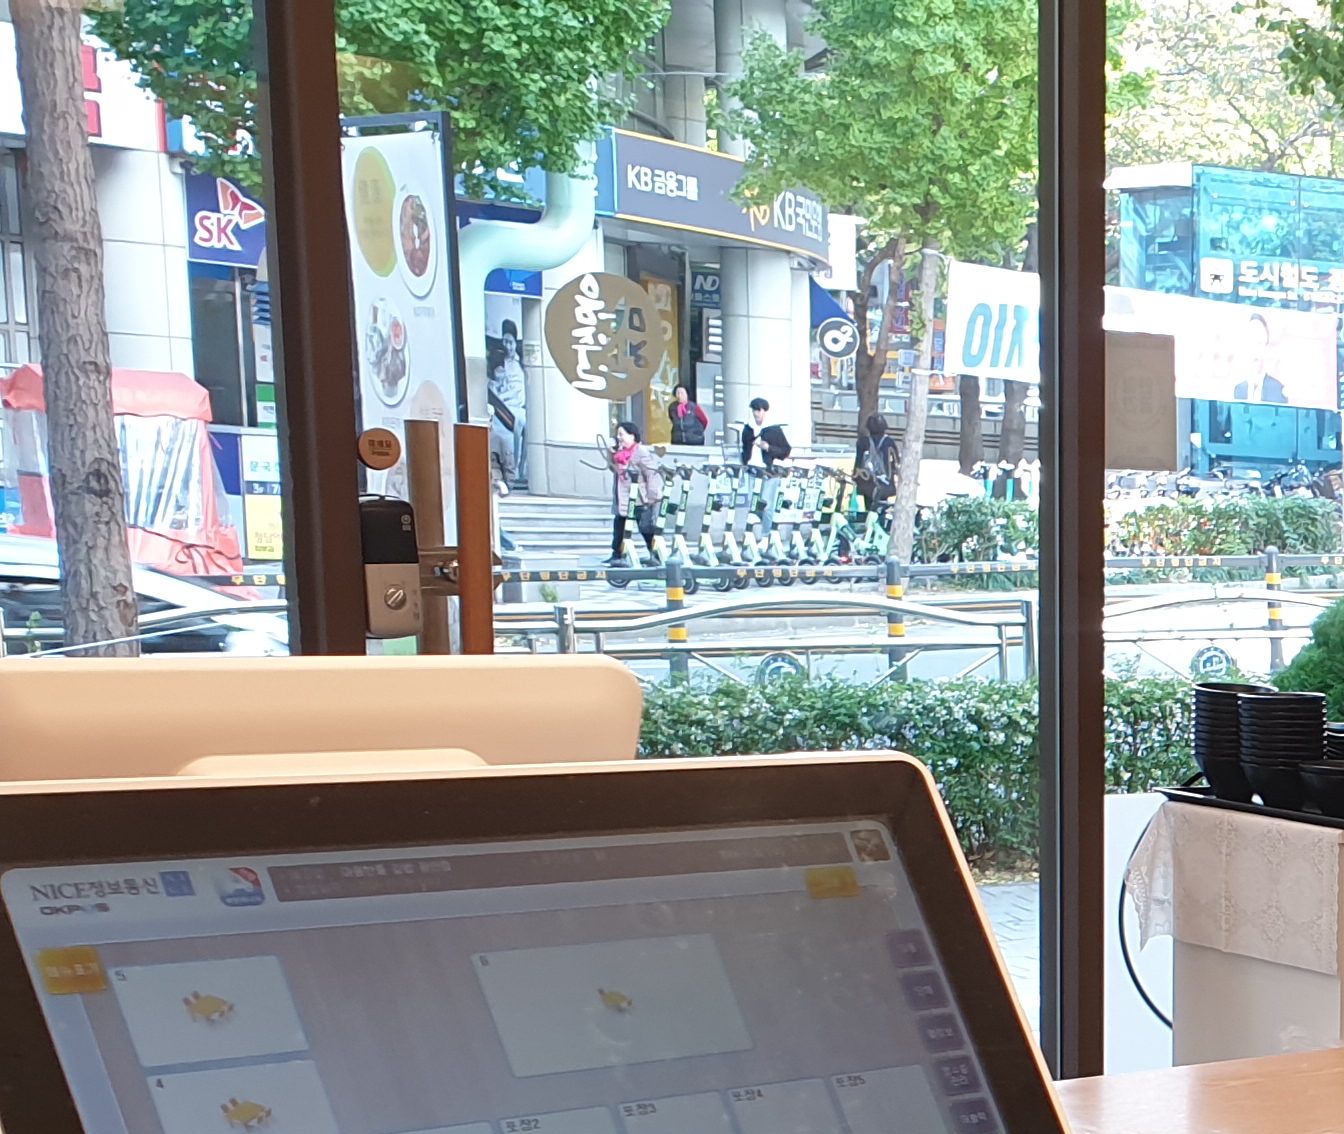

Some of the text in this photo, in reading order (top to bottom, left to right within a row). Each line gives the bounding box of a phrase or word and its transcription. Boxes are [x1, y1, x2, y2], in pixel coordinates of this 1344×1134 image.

[195, 211, 240, 249] SK
[622, 1102, 658, 1118] 포장3
[505, 1117, 542, 1133] 포장2
